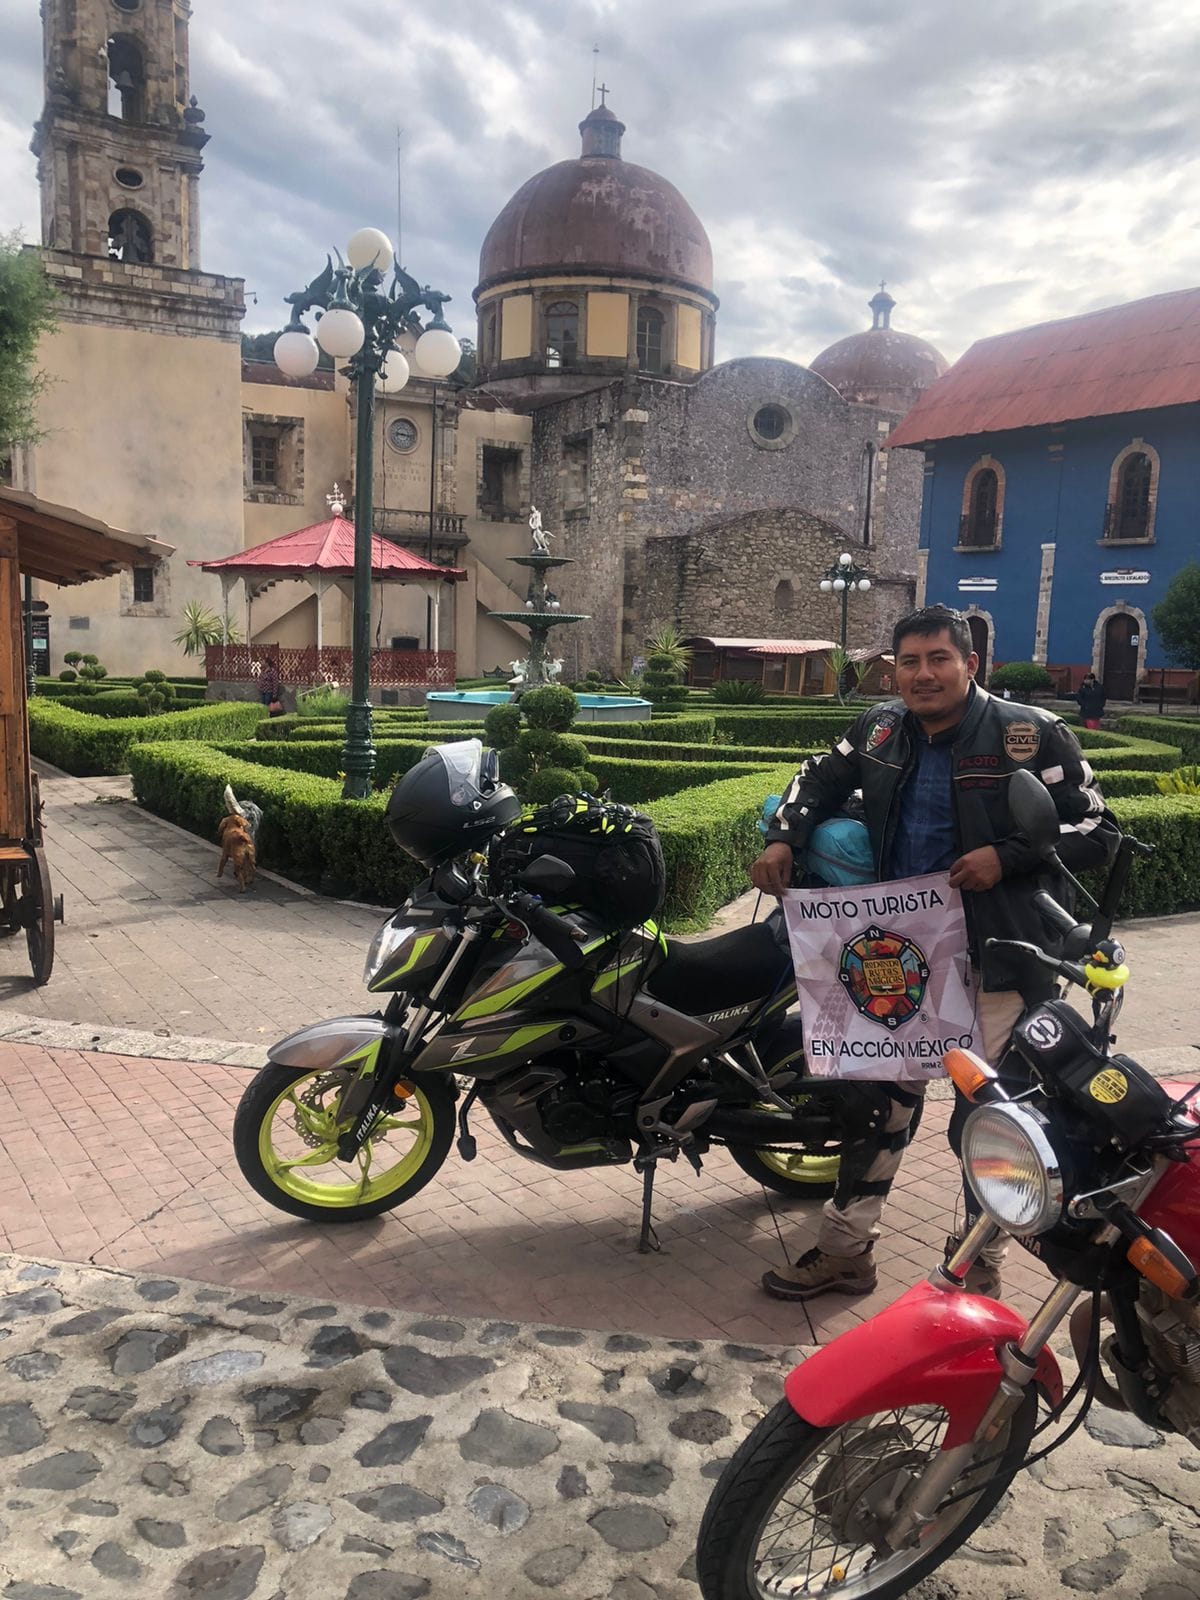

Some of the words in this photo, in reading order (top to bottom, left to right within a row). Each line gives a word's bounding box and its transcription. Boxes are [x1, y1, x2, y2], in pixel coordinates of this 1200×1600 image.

[1007, 736, 1038, 744] CIVIL
[799, 901, 859, 920] MOTO
[862, 889, 944, 916] TURISTA
[869, 929, 880, 938] N
[1117, 951, 1124, 962] 8
[921, 969, 929, 978] E
[707, 1006, 750, 1023] ITALIKA
[887, 1017, 898, 1027] S
[811, 1039, 835, 1056] EN
[839, 1037, 905, 1058] ACCIÓN
[907, 1035, 974, 1058] MÉXICO
[356, 1103, 378, 1142] ITALIKA
[1017, 1234, 1041, 1255] AHA
